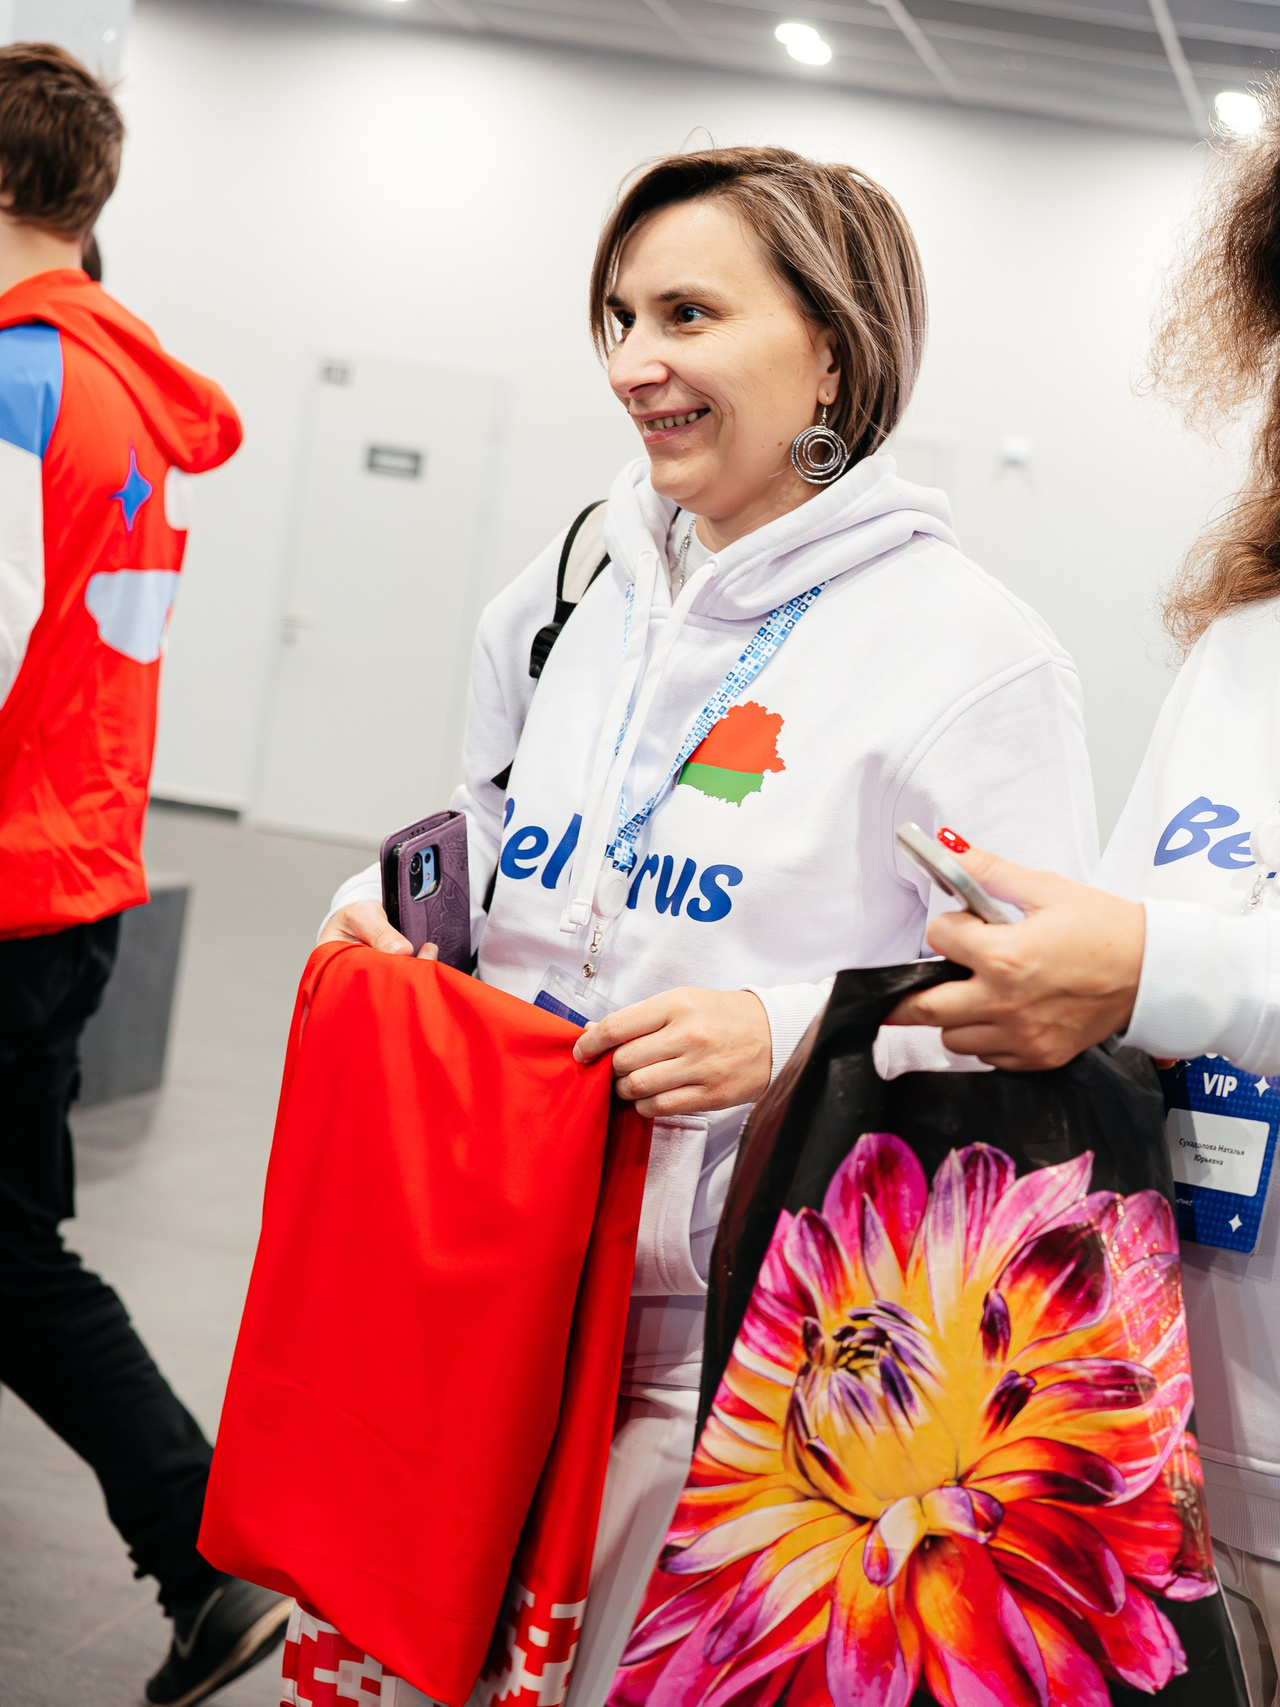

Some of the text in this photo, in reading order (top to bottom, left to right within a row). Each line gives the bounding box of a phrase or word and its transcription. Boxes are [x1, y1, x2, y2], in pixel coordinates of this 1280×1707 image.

[500, 797, 743, 922] elrus
[1203, 1072, 1238, 1098] VIP
[1217, 1144, 1245, 1155] Наталья
